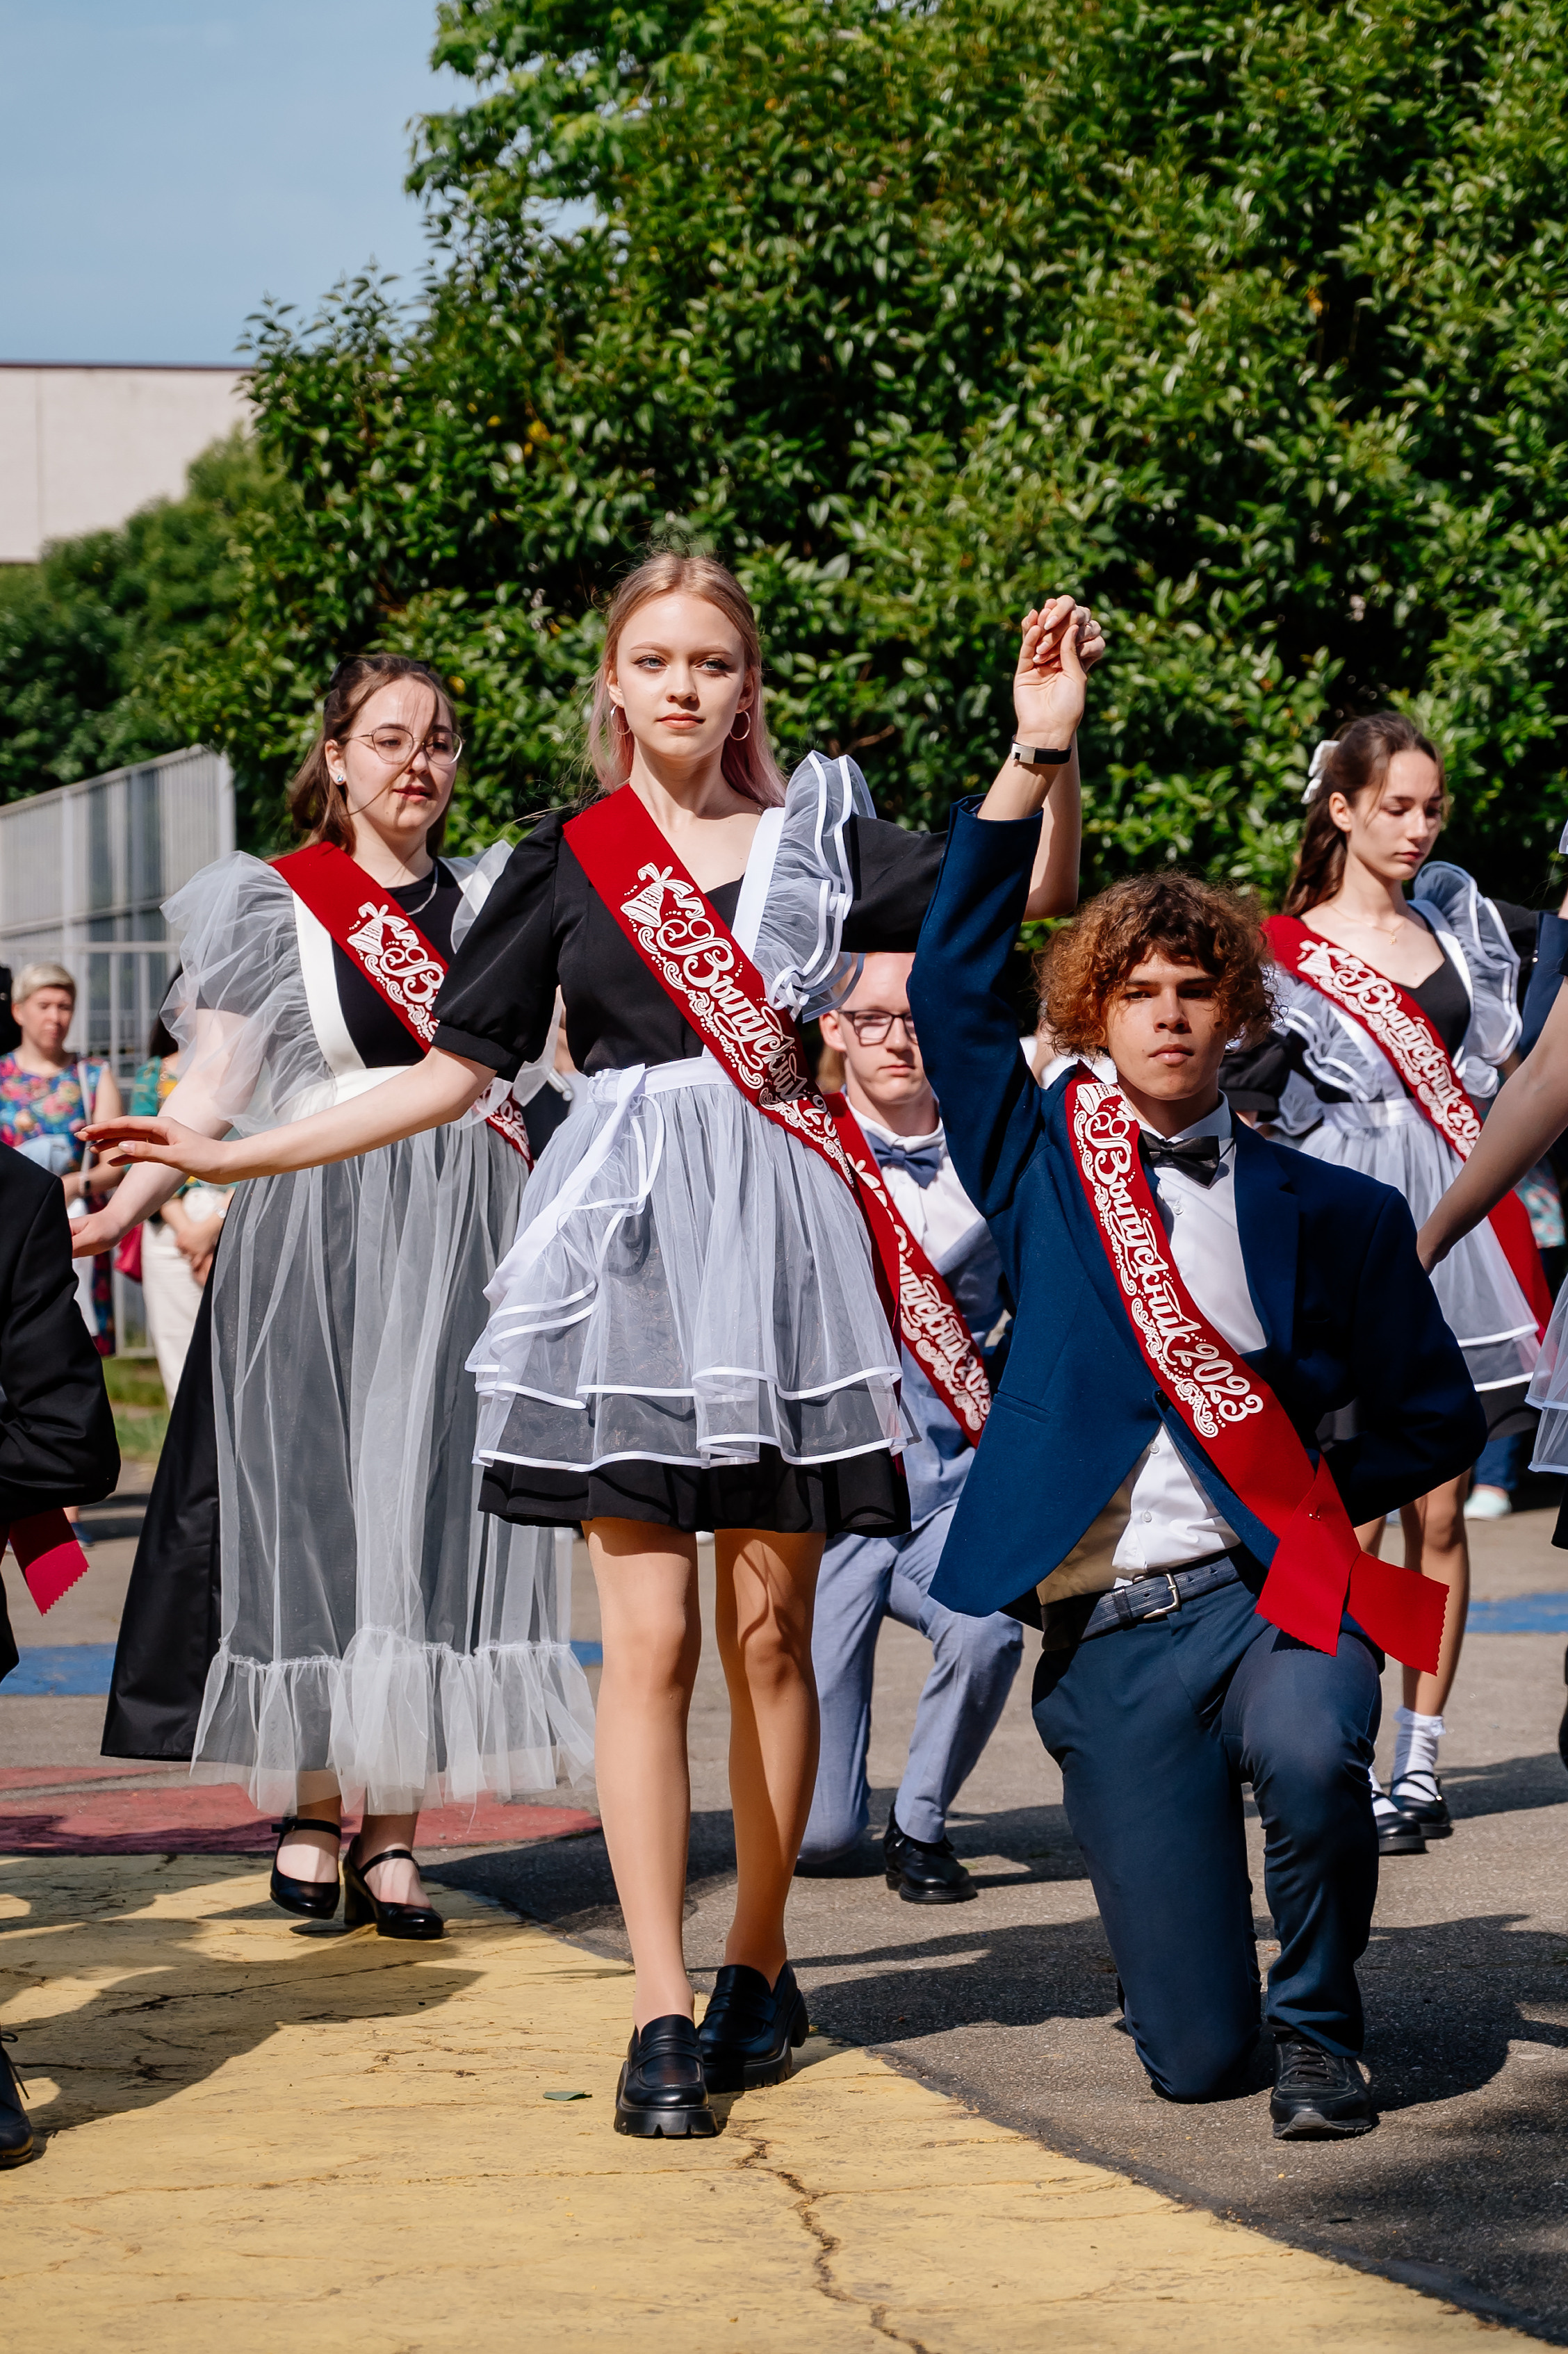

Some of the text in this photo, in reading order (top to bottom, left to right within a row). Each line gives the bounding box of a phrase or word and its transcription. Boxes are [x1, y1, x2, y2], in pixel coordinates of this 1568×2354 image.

[656, 918, 812, 1127] Выпускник
[1333, 967, 1482, 1148] Выпускник 20
[1085, 1111, 1264, 1422] Выпускник 2023
